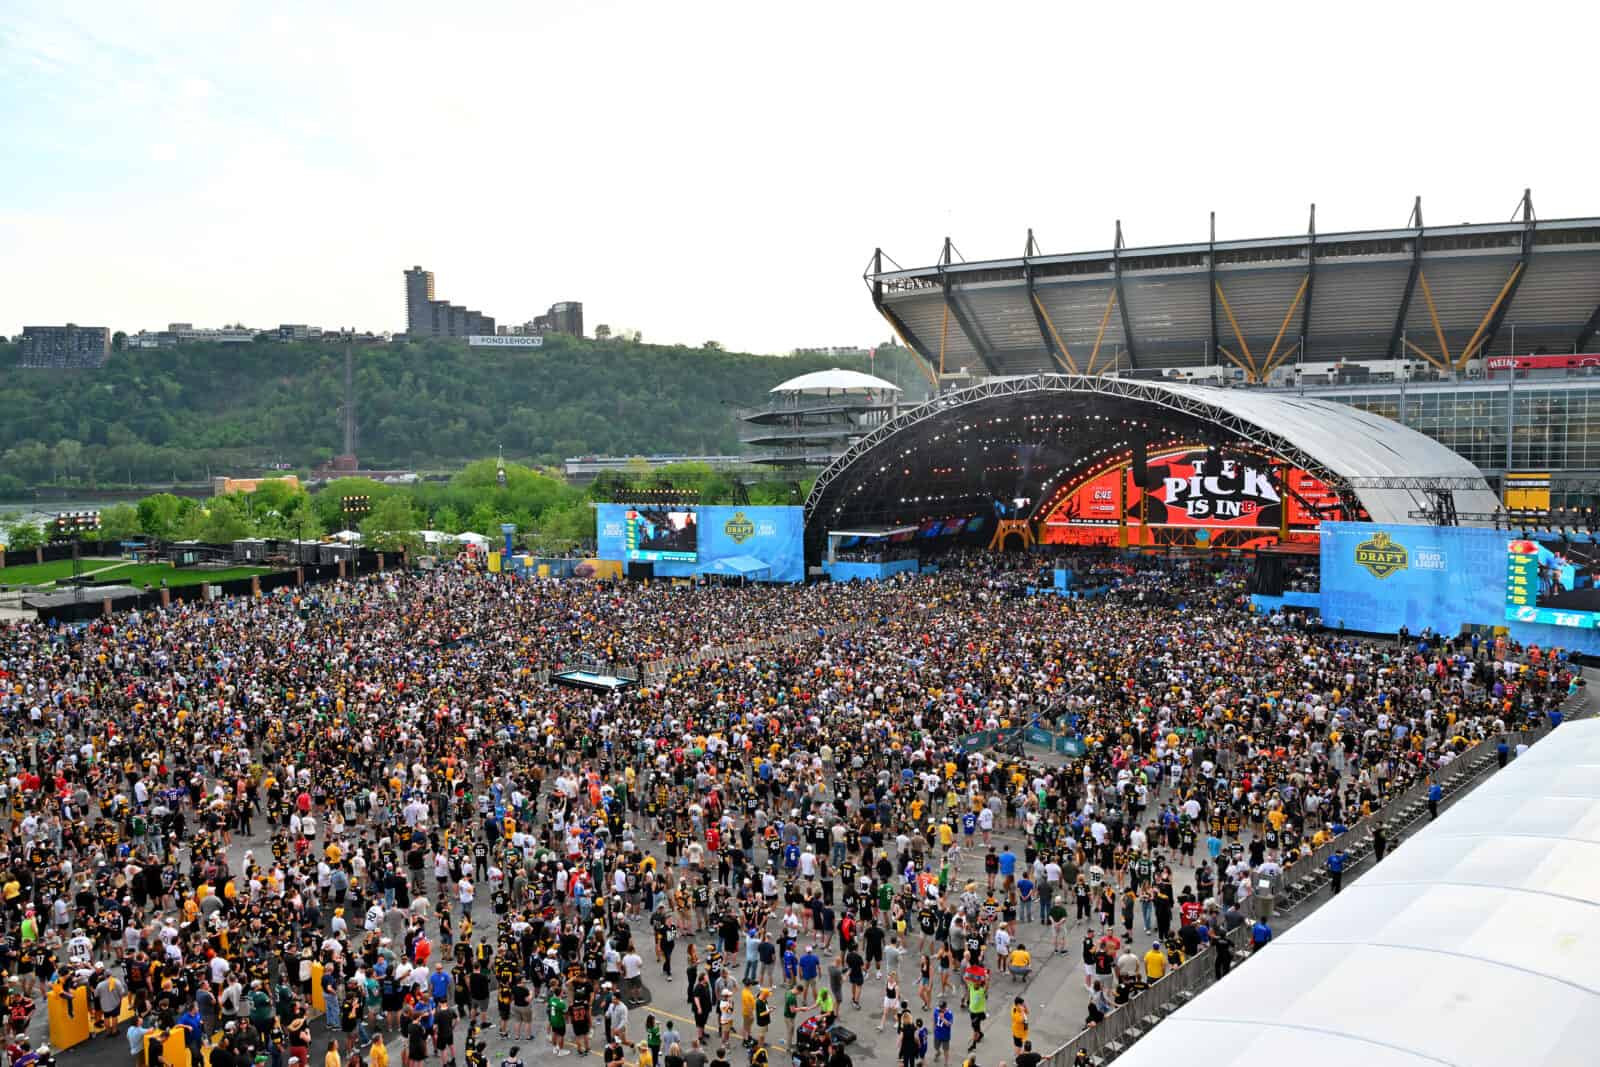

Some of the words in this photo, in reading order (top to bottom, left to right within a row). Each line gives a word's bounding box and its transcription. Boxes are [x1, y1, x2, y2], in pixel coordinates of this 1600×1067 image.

[1187, 500, 1209, 515] IS
[1216, 500, 1241, 516] IN
[1360, 552, 1403, 563] DRAFT
[73, 944, 85, 956] 13
